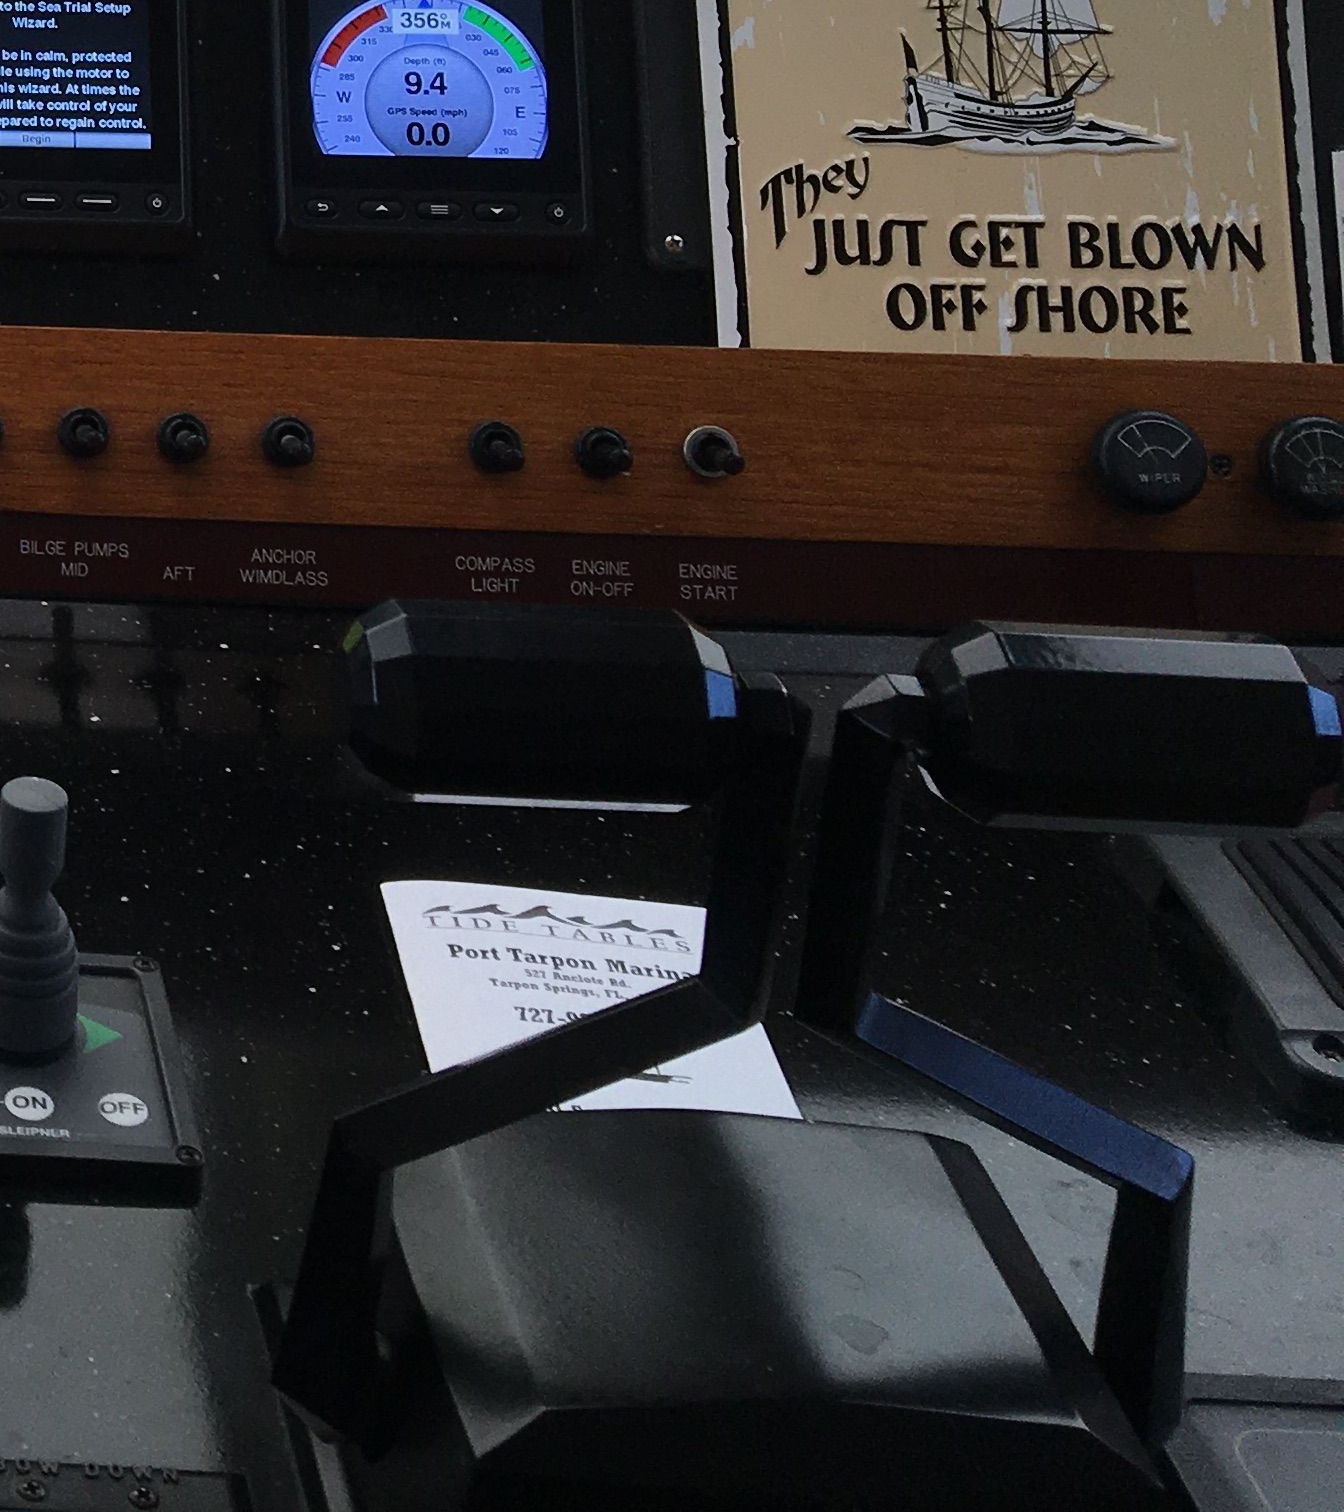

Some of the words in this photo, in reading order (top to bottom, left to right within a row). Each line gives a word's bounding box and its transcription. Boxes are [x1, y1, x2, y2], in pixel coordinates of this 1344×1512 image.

[0, 2, 12, 12] to
[15, 2, 34, 12] the
[38, 2, 61, 12] Sea
[64, 2, 91, 13] Trial
[95, 3, 131, 16] Setup
[12, 18, 58, 29] Wizard.
[2, 50, 18, 61] be
[20, 50, 32, 62] in
[36, 50, 68, 63] calm,
[72, 52, 132, 65] protected
[404, 57, 431, 66] Depth
[404, 72, 448, 96] 9.4
[336, 91, 352, 104] W
[387, 108, 407, 116] GPS
[410, 108, 437, 118] Speed
[441, 108, 467, 118] (mph)
[516, 106, 526, 119] E
[406, 122, 450, 146] 0.0
[759, 152, 871, 250] They
[805, 217, 928, 277] JUST
[948, 217, 1045, 270] GET
[1067, 218, 1268, 273] BLOWN
[886, 280, 988, 333] OFF
[1009, 282, 1193, 335] SHORE
[19, 539, 66, 557] BILGE
[74, 541, 129, 558] PUMPS
[250, 548, 317, 565] ANCHOR
[61, 561, 89, 577] MID
[455, 556, 536, 573] COMPASS
[572, 560, 630, 576] ENGINE
[679, 563, 737, 580] ENGINE
[163, 566, 196, 582] AFT
[471, 577, 519, 593] LIGHT
[570, 581, 634, 597] ON-OFF
[680, 584, 738, 600] START
[425, 915, 518, 933] TIDE
[545, 924, 692, 953] TABLES
[447, 943, 500, 961] Port
[507, 947, 596, 972] Tarpon
[489, 978, 540, 991] Tarpon
[544, 982, 601, 998] Springs,
[12, 1097, 48, 1110] ON
[100, 1101, 146, 1116] OFF
